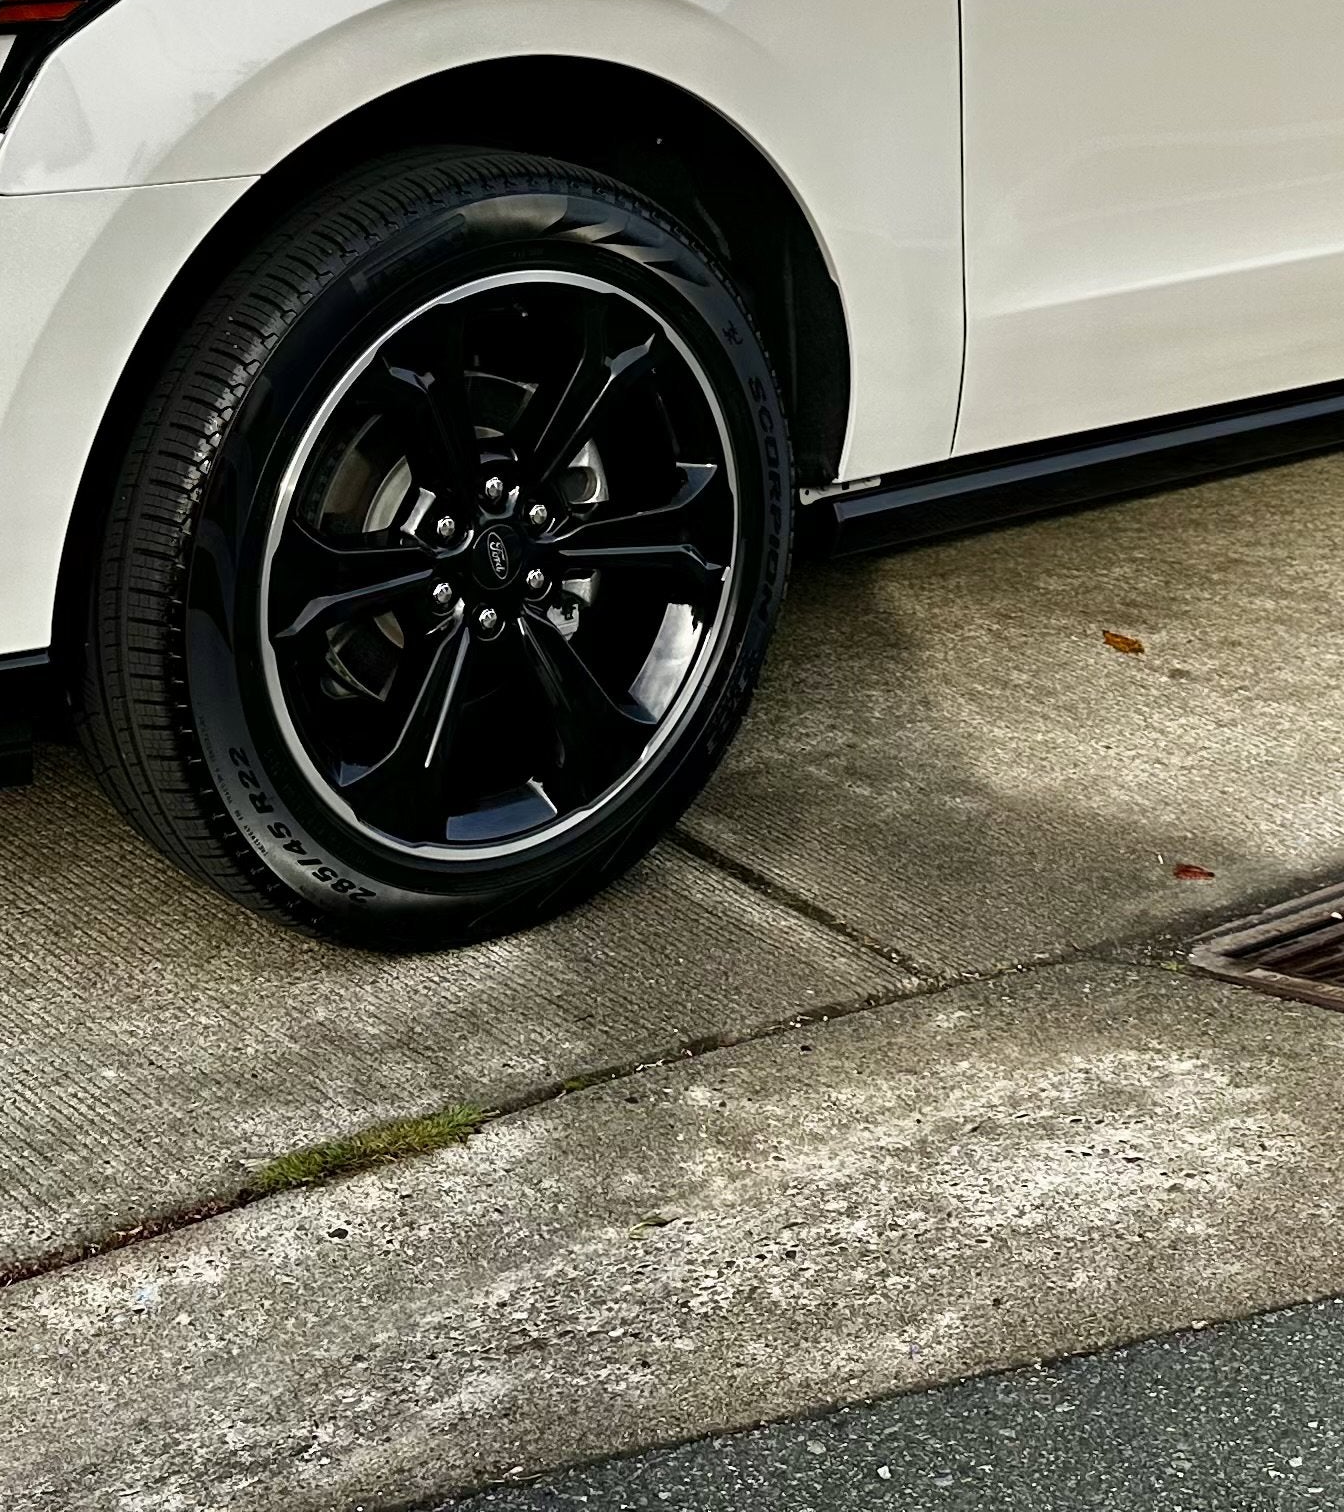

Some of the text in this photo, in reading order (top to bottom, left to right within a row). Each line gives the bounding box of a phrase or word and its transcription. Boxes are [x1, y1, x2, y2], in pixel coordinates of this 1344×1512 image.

[489, 541, 506, 573] Ford
[229, 747, 377, 903] 285/45 R22
